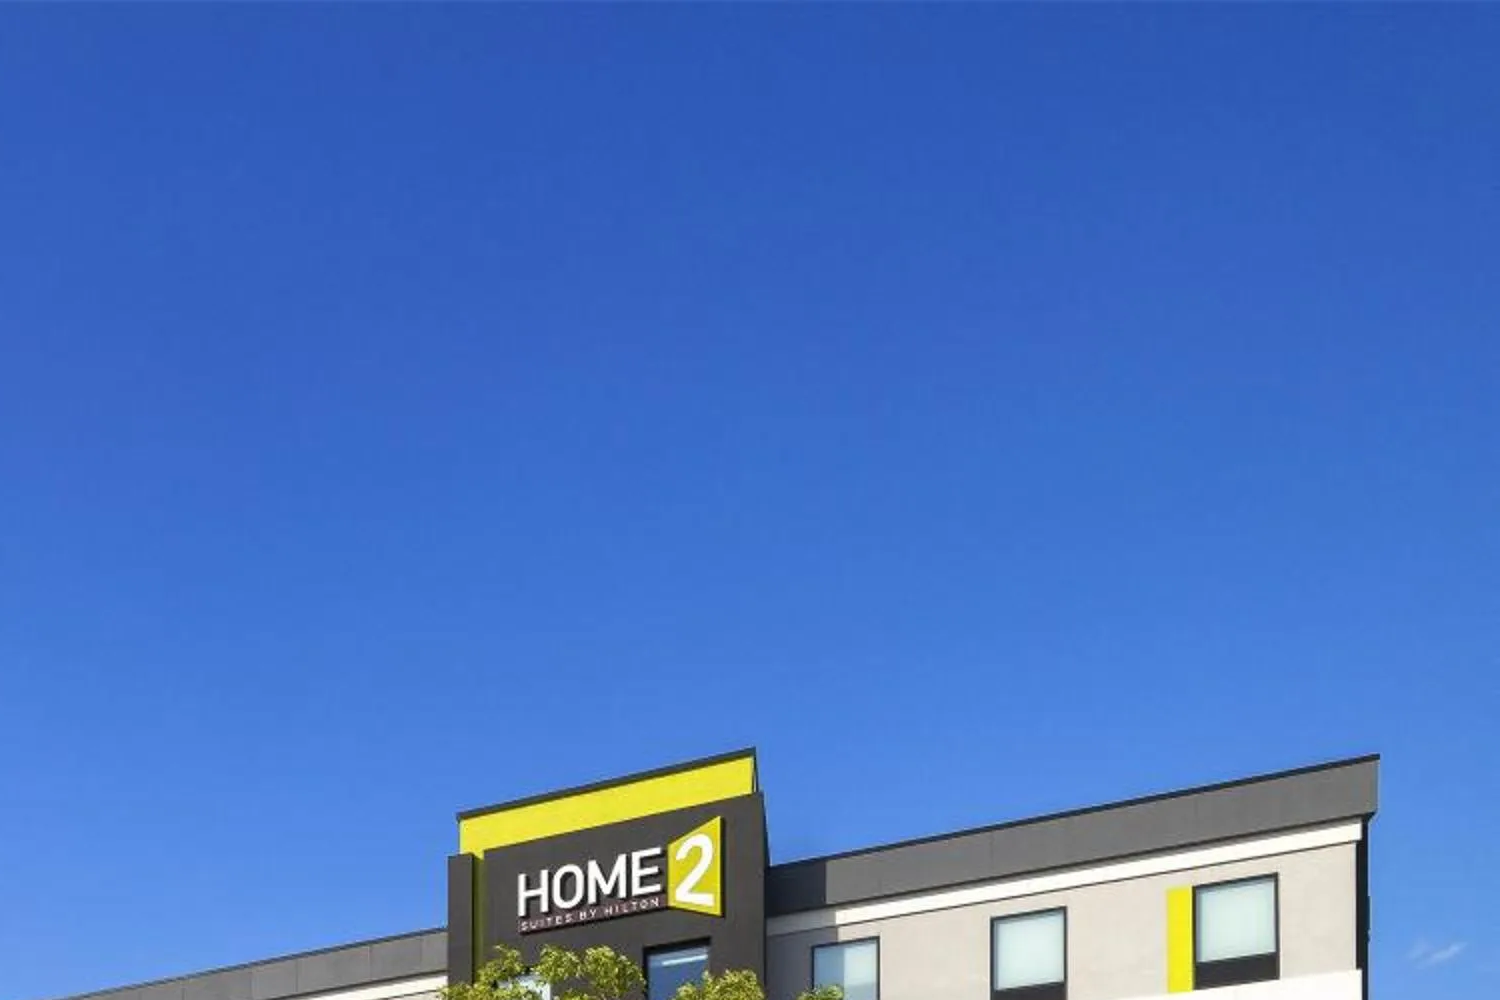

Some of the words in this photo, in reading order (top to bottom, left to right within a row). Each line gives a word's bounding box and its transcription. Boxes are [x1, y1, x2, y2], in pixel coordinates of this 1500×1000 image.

[517, 846, 662, 917] HOME
[675, 832, 716, 908] 2
[520, 913, 574, 932] SUITES
[579, 908, 597, 921] BY
[604, 897, 659, 918] HILTON
